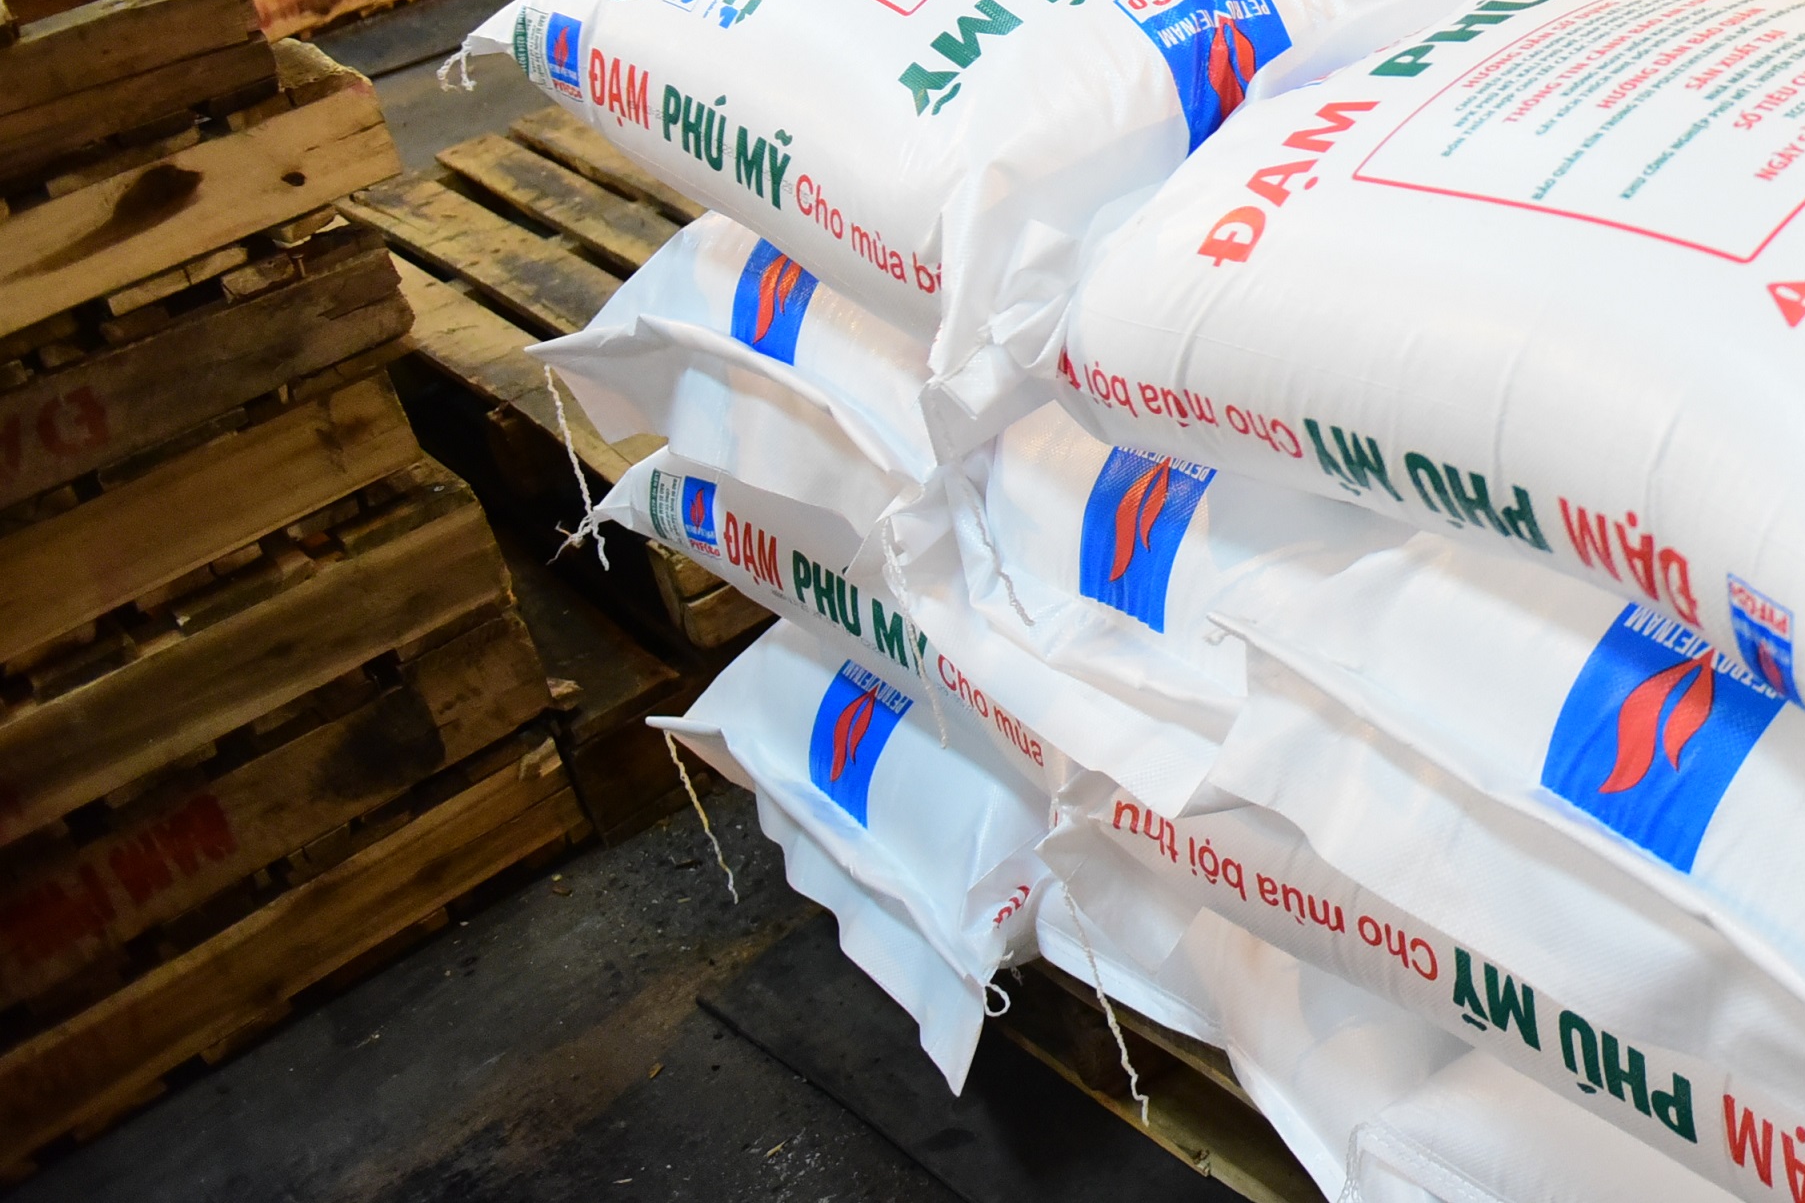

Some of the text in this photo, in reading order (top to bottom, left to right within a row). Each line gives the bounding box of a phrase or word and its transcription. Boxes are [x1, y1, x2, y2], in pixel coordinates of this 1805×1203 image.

[1732, 110, 1763, 131] SỐ
[1754, 86, 1798, 112] TIÊU
[588, 48, 650, 130] ĐẠM
[663, 84, 727, 172] PHÚ
[736, 125, 793, 211] MỸ
[796, 174, 844, 240] Cho
[851, 222, 907, 284] mùa
[1197, 101, 1381, 267] ĐẠM
[1755, 143, 1804, 181] NGÀY
[1084, 360, 1138, 419] bội
[1138, 382, 1219, 427] mùa
[1225, 404, 1303, 459] Cho
[1303, 418, 1403, 502] MỸ
[1404, 451, 1553, 554] PHÚ
[1559, 496, 1703, 631] ĐẠM
[724, 511, 783, 592] ĐẠM
[937, 653, 989, 718] Cho
[993, 705, 1044, 767] mùa
[1113, 799, 1178, 864] thu
[1189, 836, 1248, 902] bội
[1255, 872, 1345, 935] mùa
[1356, 914, 1438, 981] Cho
[1453, 946, 1541, 1052] MỸ
[1559, 1010, 1698, 1144] PHÚ
